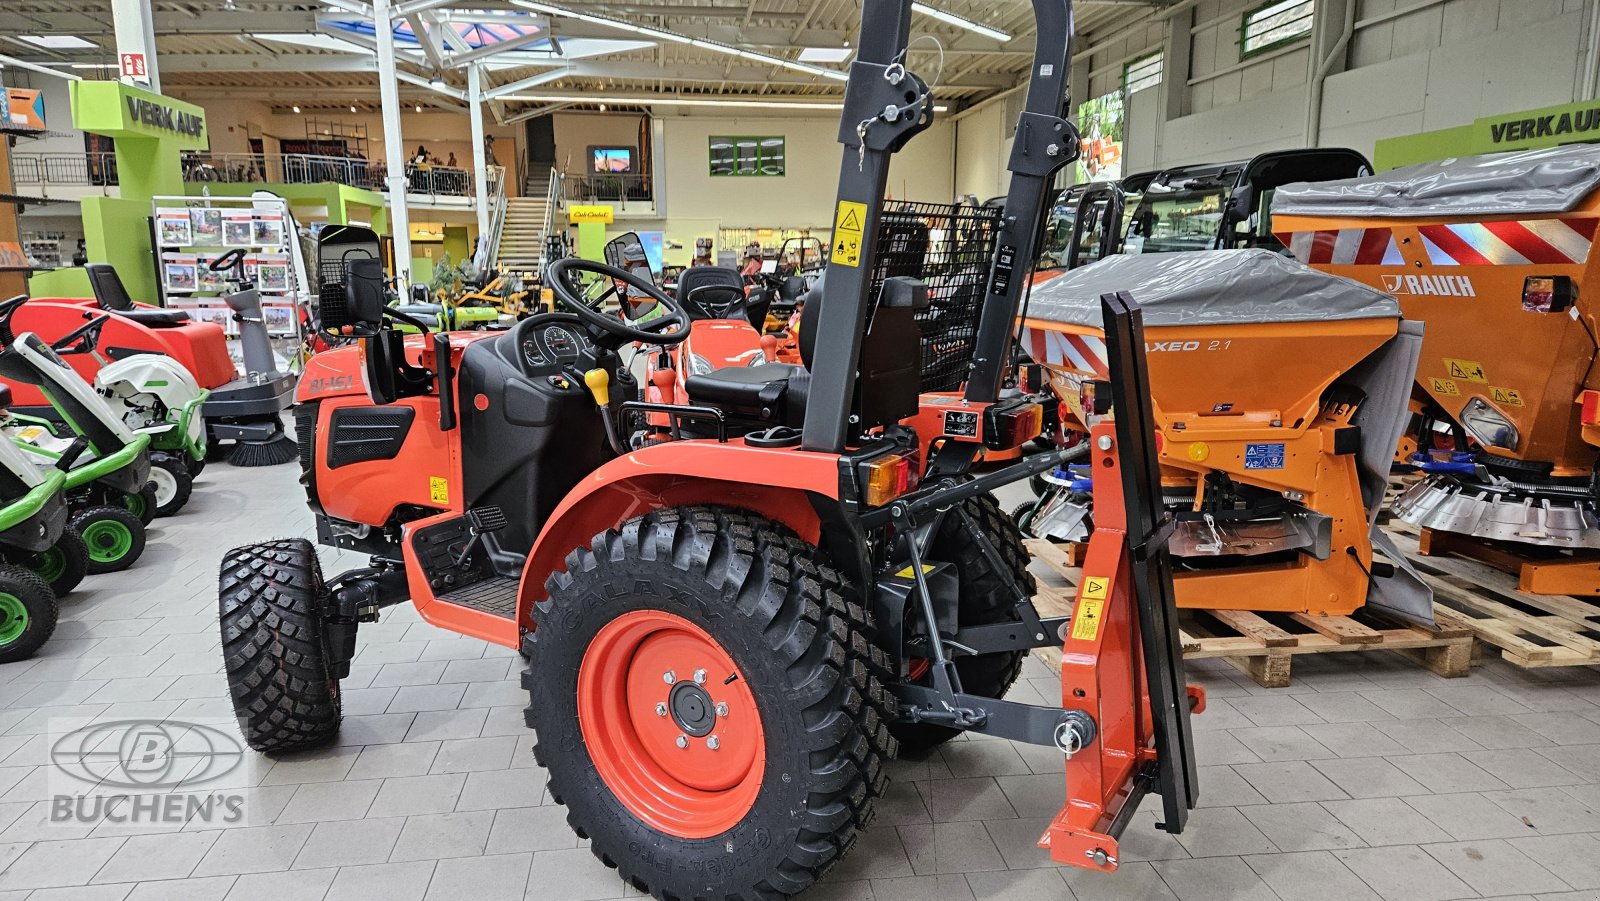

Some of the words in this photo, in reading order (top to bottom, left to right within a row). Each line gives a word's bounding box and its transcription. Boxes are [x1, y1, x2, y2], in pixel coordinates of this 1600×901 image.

[126, 95, 204, 138] VERKAUF
[1405, 274, 1477, 297] RAUCH
[1207, 339, 1232, 351] 2.1
